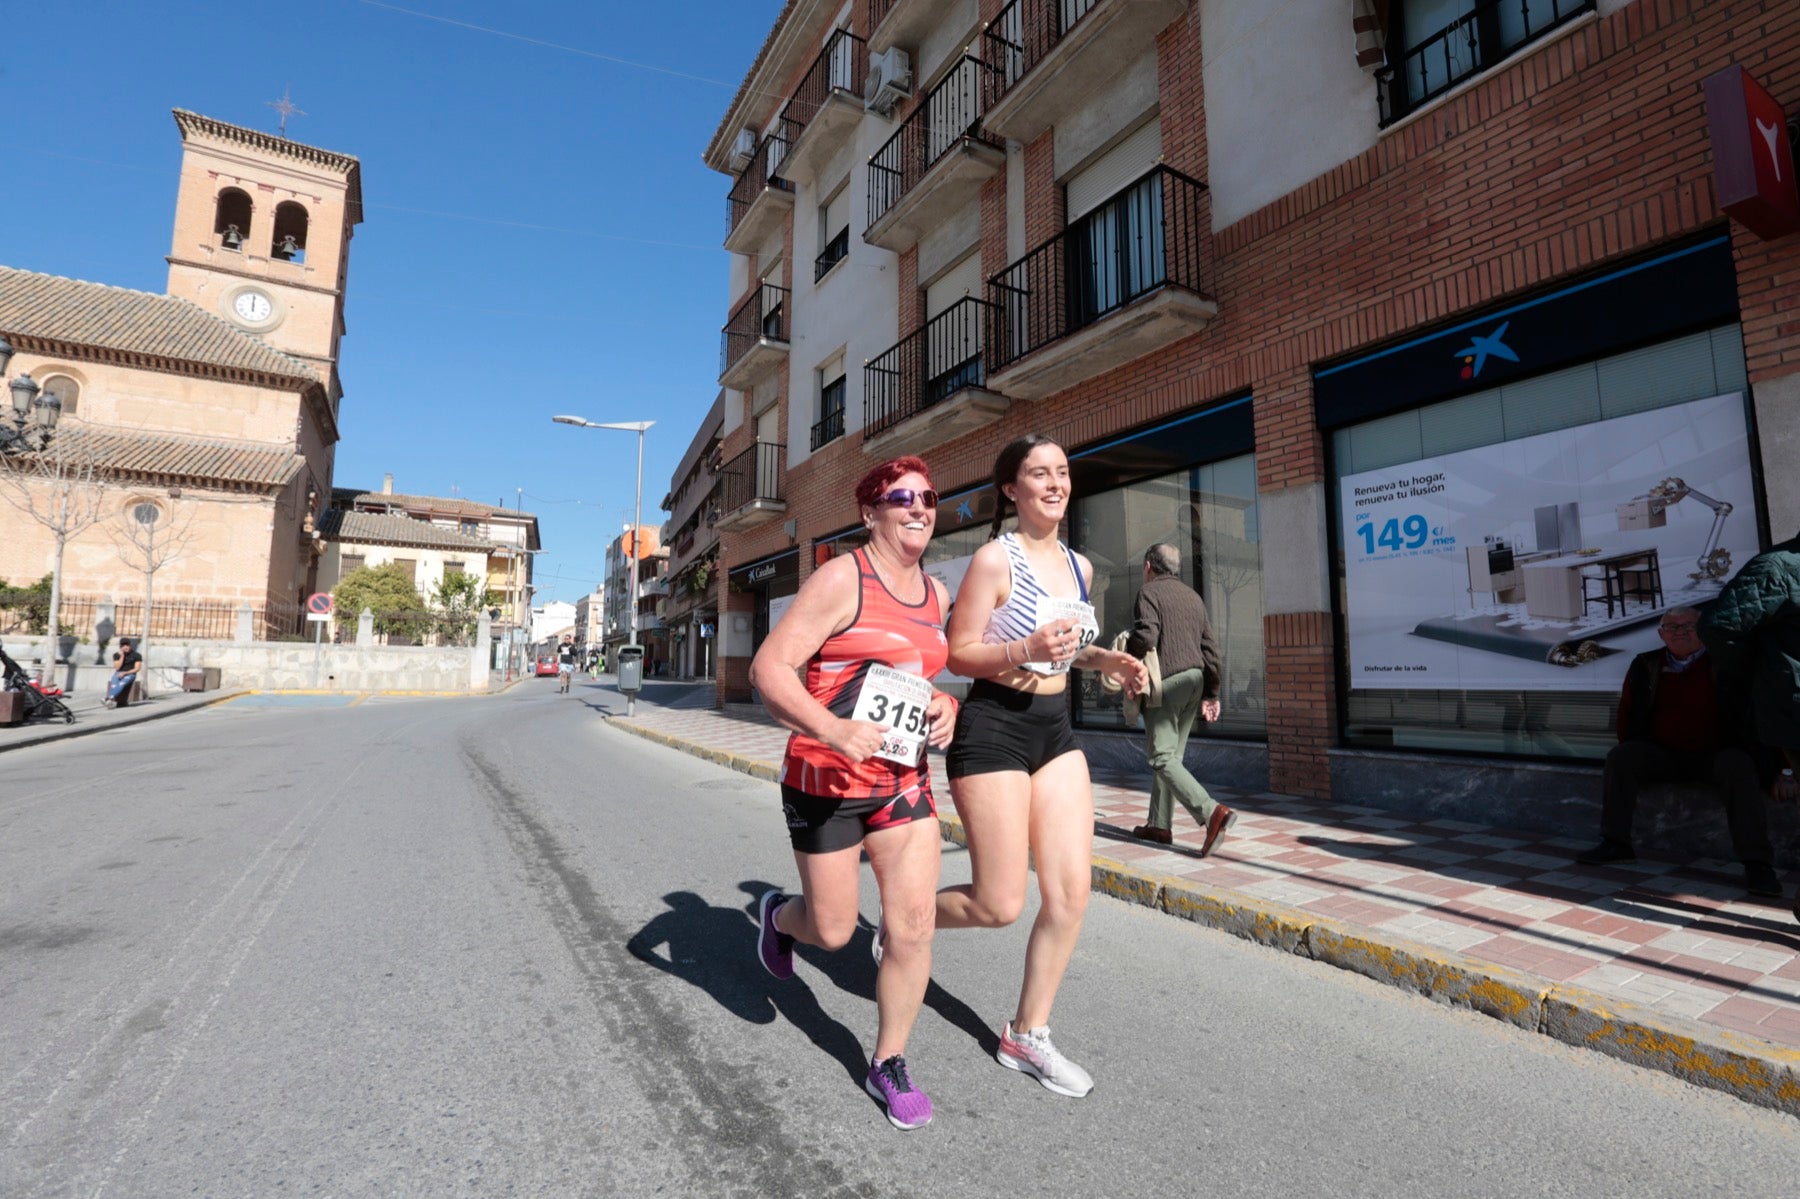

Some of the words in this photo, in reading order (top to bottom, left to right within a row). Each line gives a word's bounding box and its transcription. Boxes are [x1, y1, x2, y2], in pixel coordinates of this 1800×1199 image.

[1354, 482, 1396, 496] Renueva
[1399, 479, 1410, 488] tu
[1412, 472, 1446, 487] hogar,
[1355, 493, 1394, 506] renueva
[1397, 490, 1408, 499] tu
[1410, 483, 1445, 496] ilusión
[1356, 512, 1371, 522] por
[1357, 514, 1428, 554] 149
[1432, 536, 1456, 546] mes
